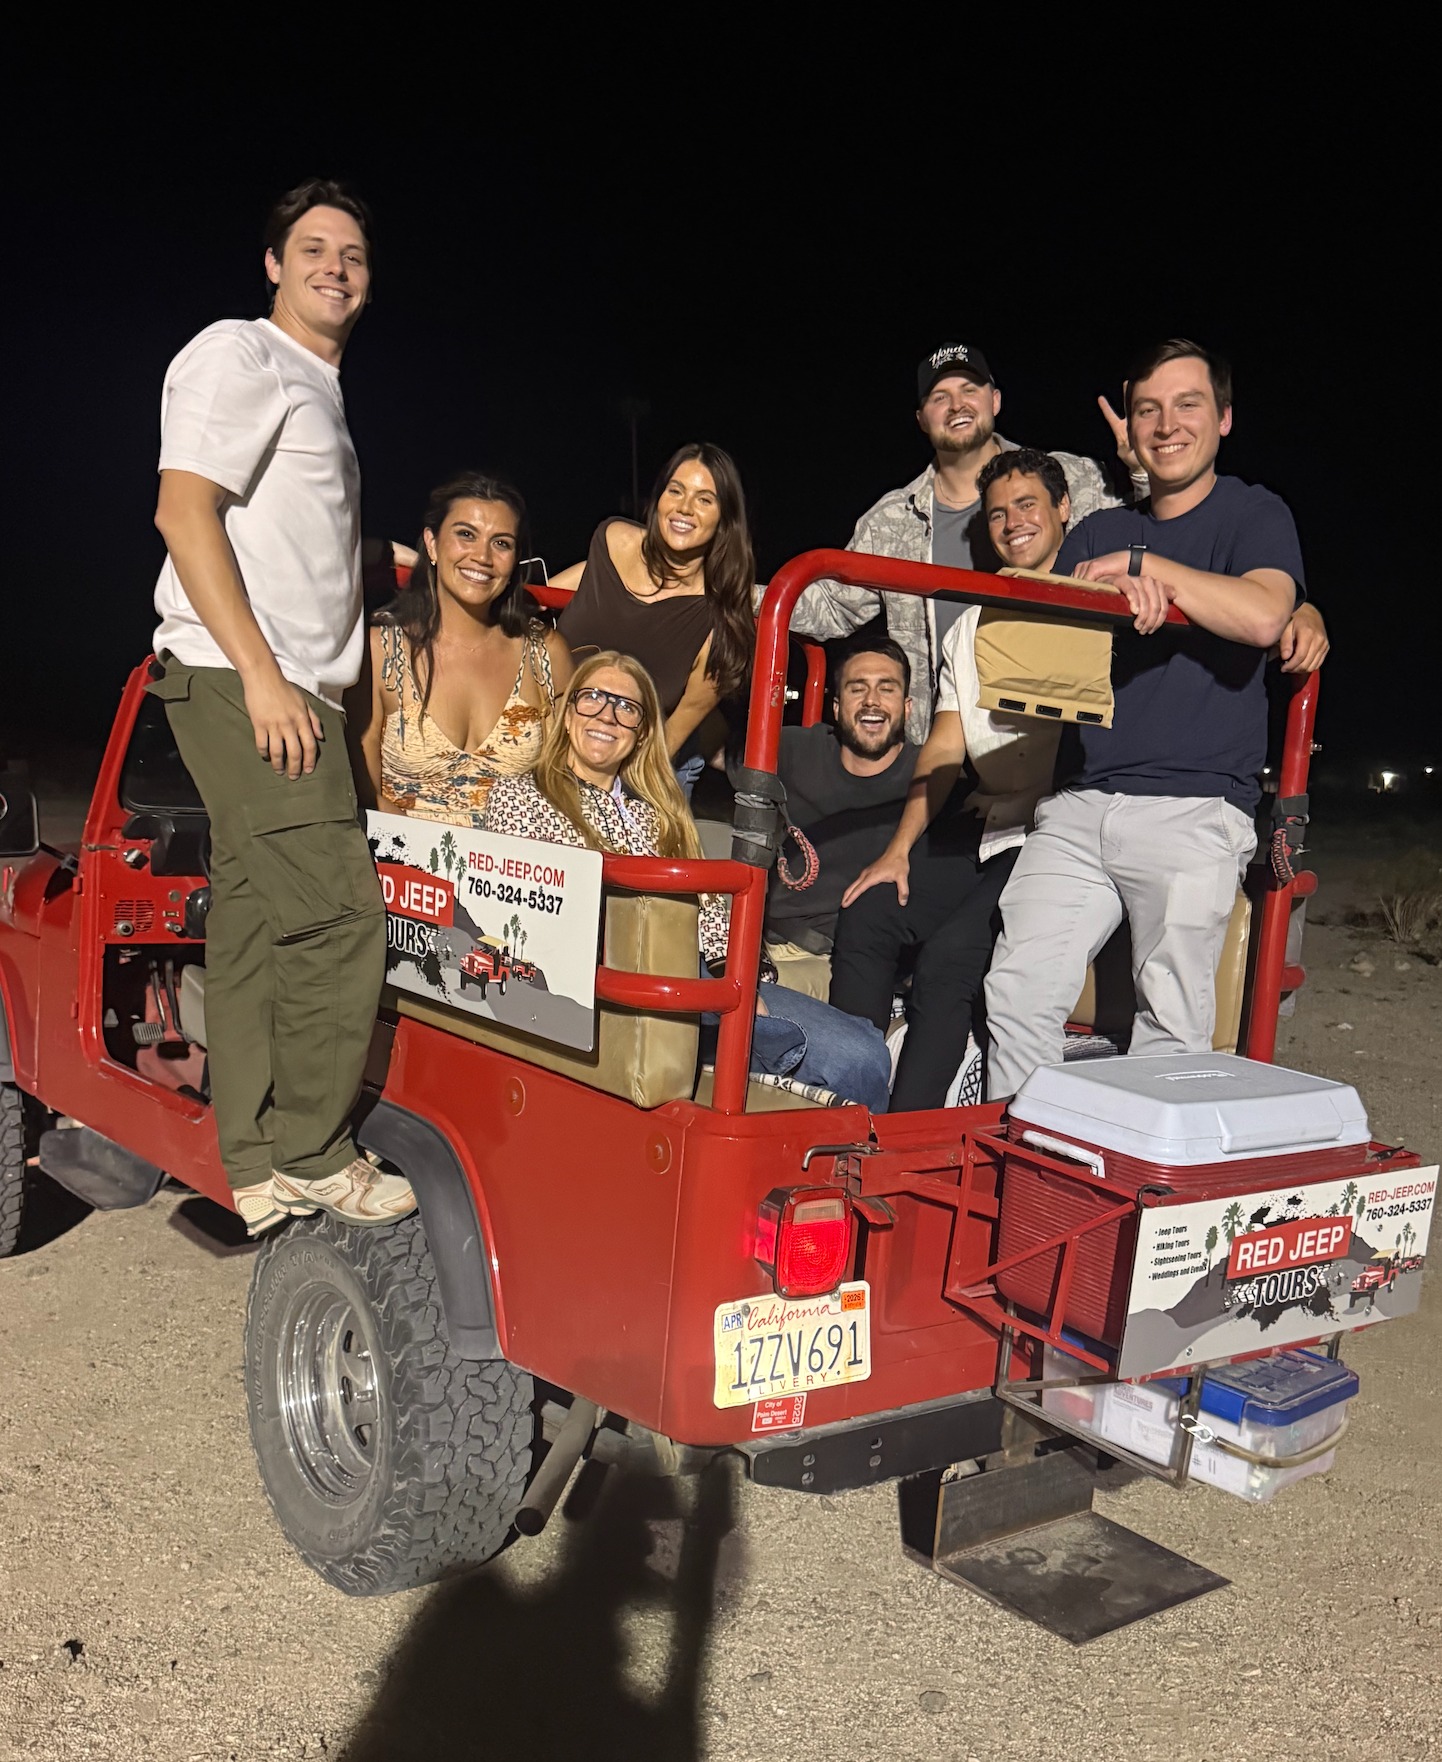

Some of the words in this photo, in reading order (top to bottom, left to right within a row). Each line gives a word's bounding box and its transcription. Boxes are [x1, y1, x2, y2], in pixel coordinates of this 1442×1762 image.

[469, 852, 565, 888] RED-JEEP.COM
[400, 879, 448, 917] JEEP
[468, 877, 563, 915] 760-324-5337
[387, 914, 428, 958] OURS
[1368, 1181, 1435, 1204] RED-JEEP.COM
[1366, 1198, 1432, 1222] 760-324-5337
[1158, 1228, 1171, 1236] Jeep
[1173, 1226, 1187, 1234] Tours
[1156, 1242, 1174, 1251] Hiking
[1175, 1240, 1190, 1248] Tours
[1236, 1237, 1285, 1271] RED
[1290, 1225, 1345, 1261] JEEP
[1154, 1254, 1186, 1266] Sightseeing
[1187, 1252, 1202, 1260] Tours
[1152, 1270, 1179, 1280] Weddings
[1180, 1267, 1190, 1275] and
[1254, 1265, 1319, 1308] TOURS
[723, 1312, 742, 1330] APR
[748, 1303, 841, 1331] California
[732, 1321, 863, 1390] 1ZZV691
[759, 1372, 828, 1395] LIVERY
[765, 1401, 775, 1409] City
[771, 1409, 788, 1417] Desert
[791, 1396, 803, 1424] 2025
